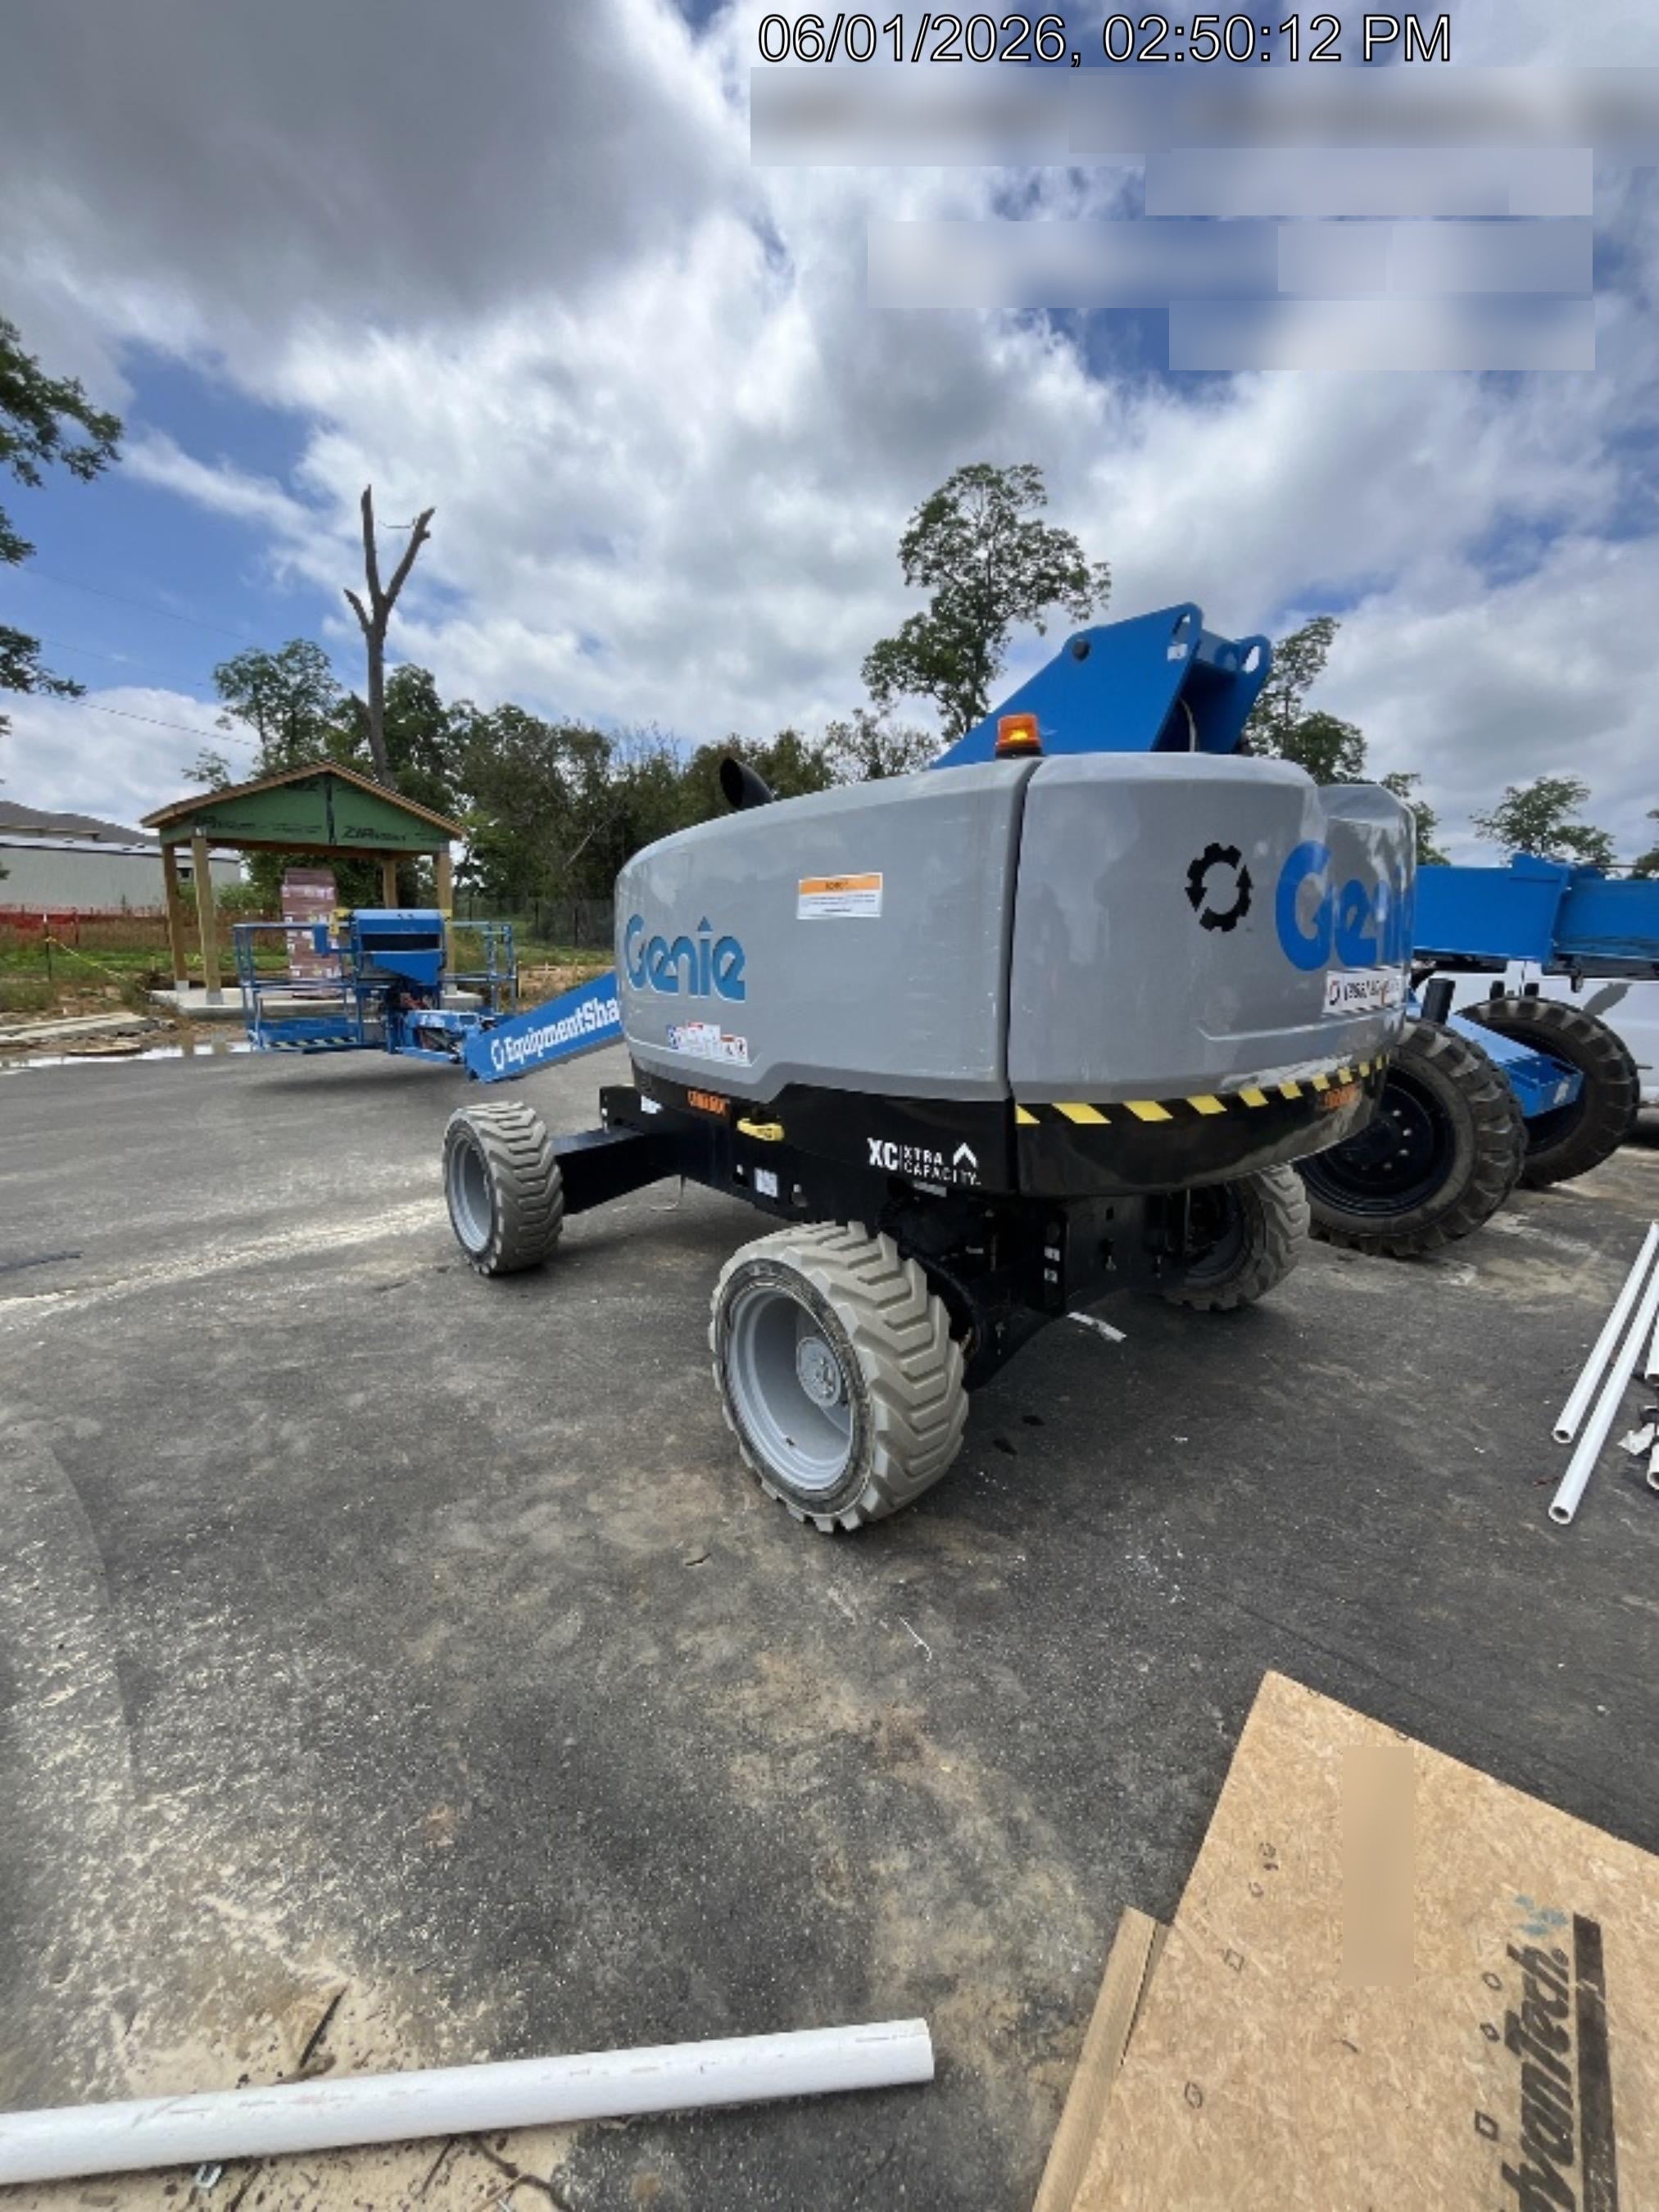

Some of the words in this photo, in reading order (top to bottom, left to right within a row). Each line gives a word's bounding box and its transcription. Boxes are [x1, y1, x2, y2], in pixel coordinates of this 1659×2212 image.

[624, 913, 746, 1002] Genie
[867, 1137, 898, 1171] XC
[903, 1145, 943, 1166] XTRA
